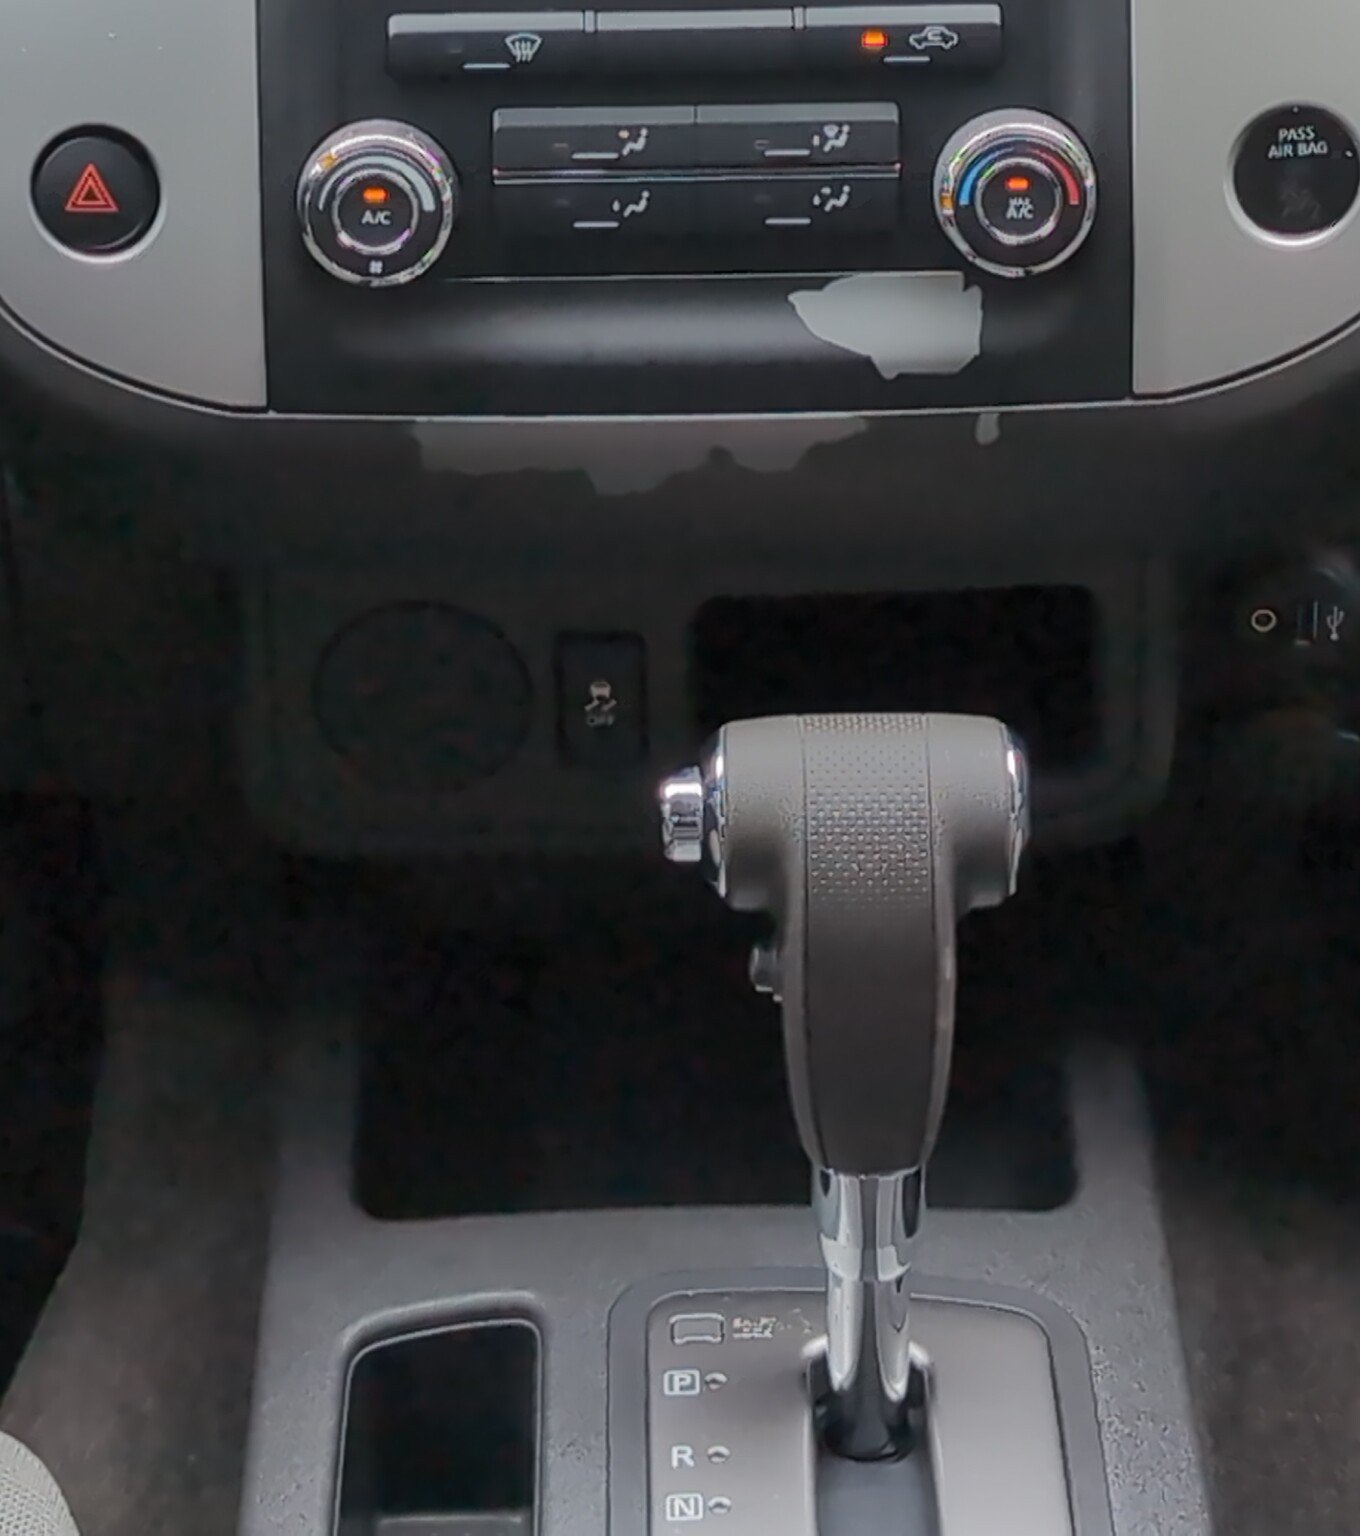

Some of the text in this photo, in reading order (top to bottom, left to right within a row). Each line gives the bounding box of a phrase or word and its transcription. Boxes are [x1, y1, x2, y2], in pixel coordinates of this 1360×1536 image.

[1278, 126, 1315, 141] PASS
[1268, 142, 1328, 159] AIR BAG
[362, 209, 391, 226] A/C
[1006, 203, 1034, 219] A/C
[673, 1374, 692, 1392] P
[671, 1446, 695, 1468] R
[673, 1499, 696, 1517] N
